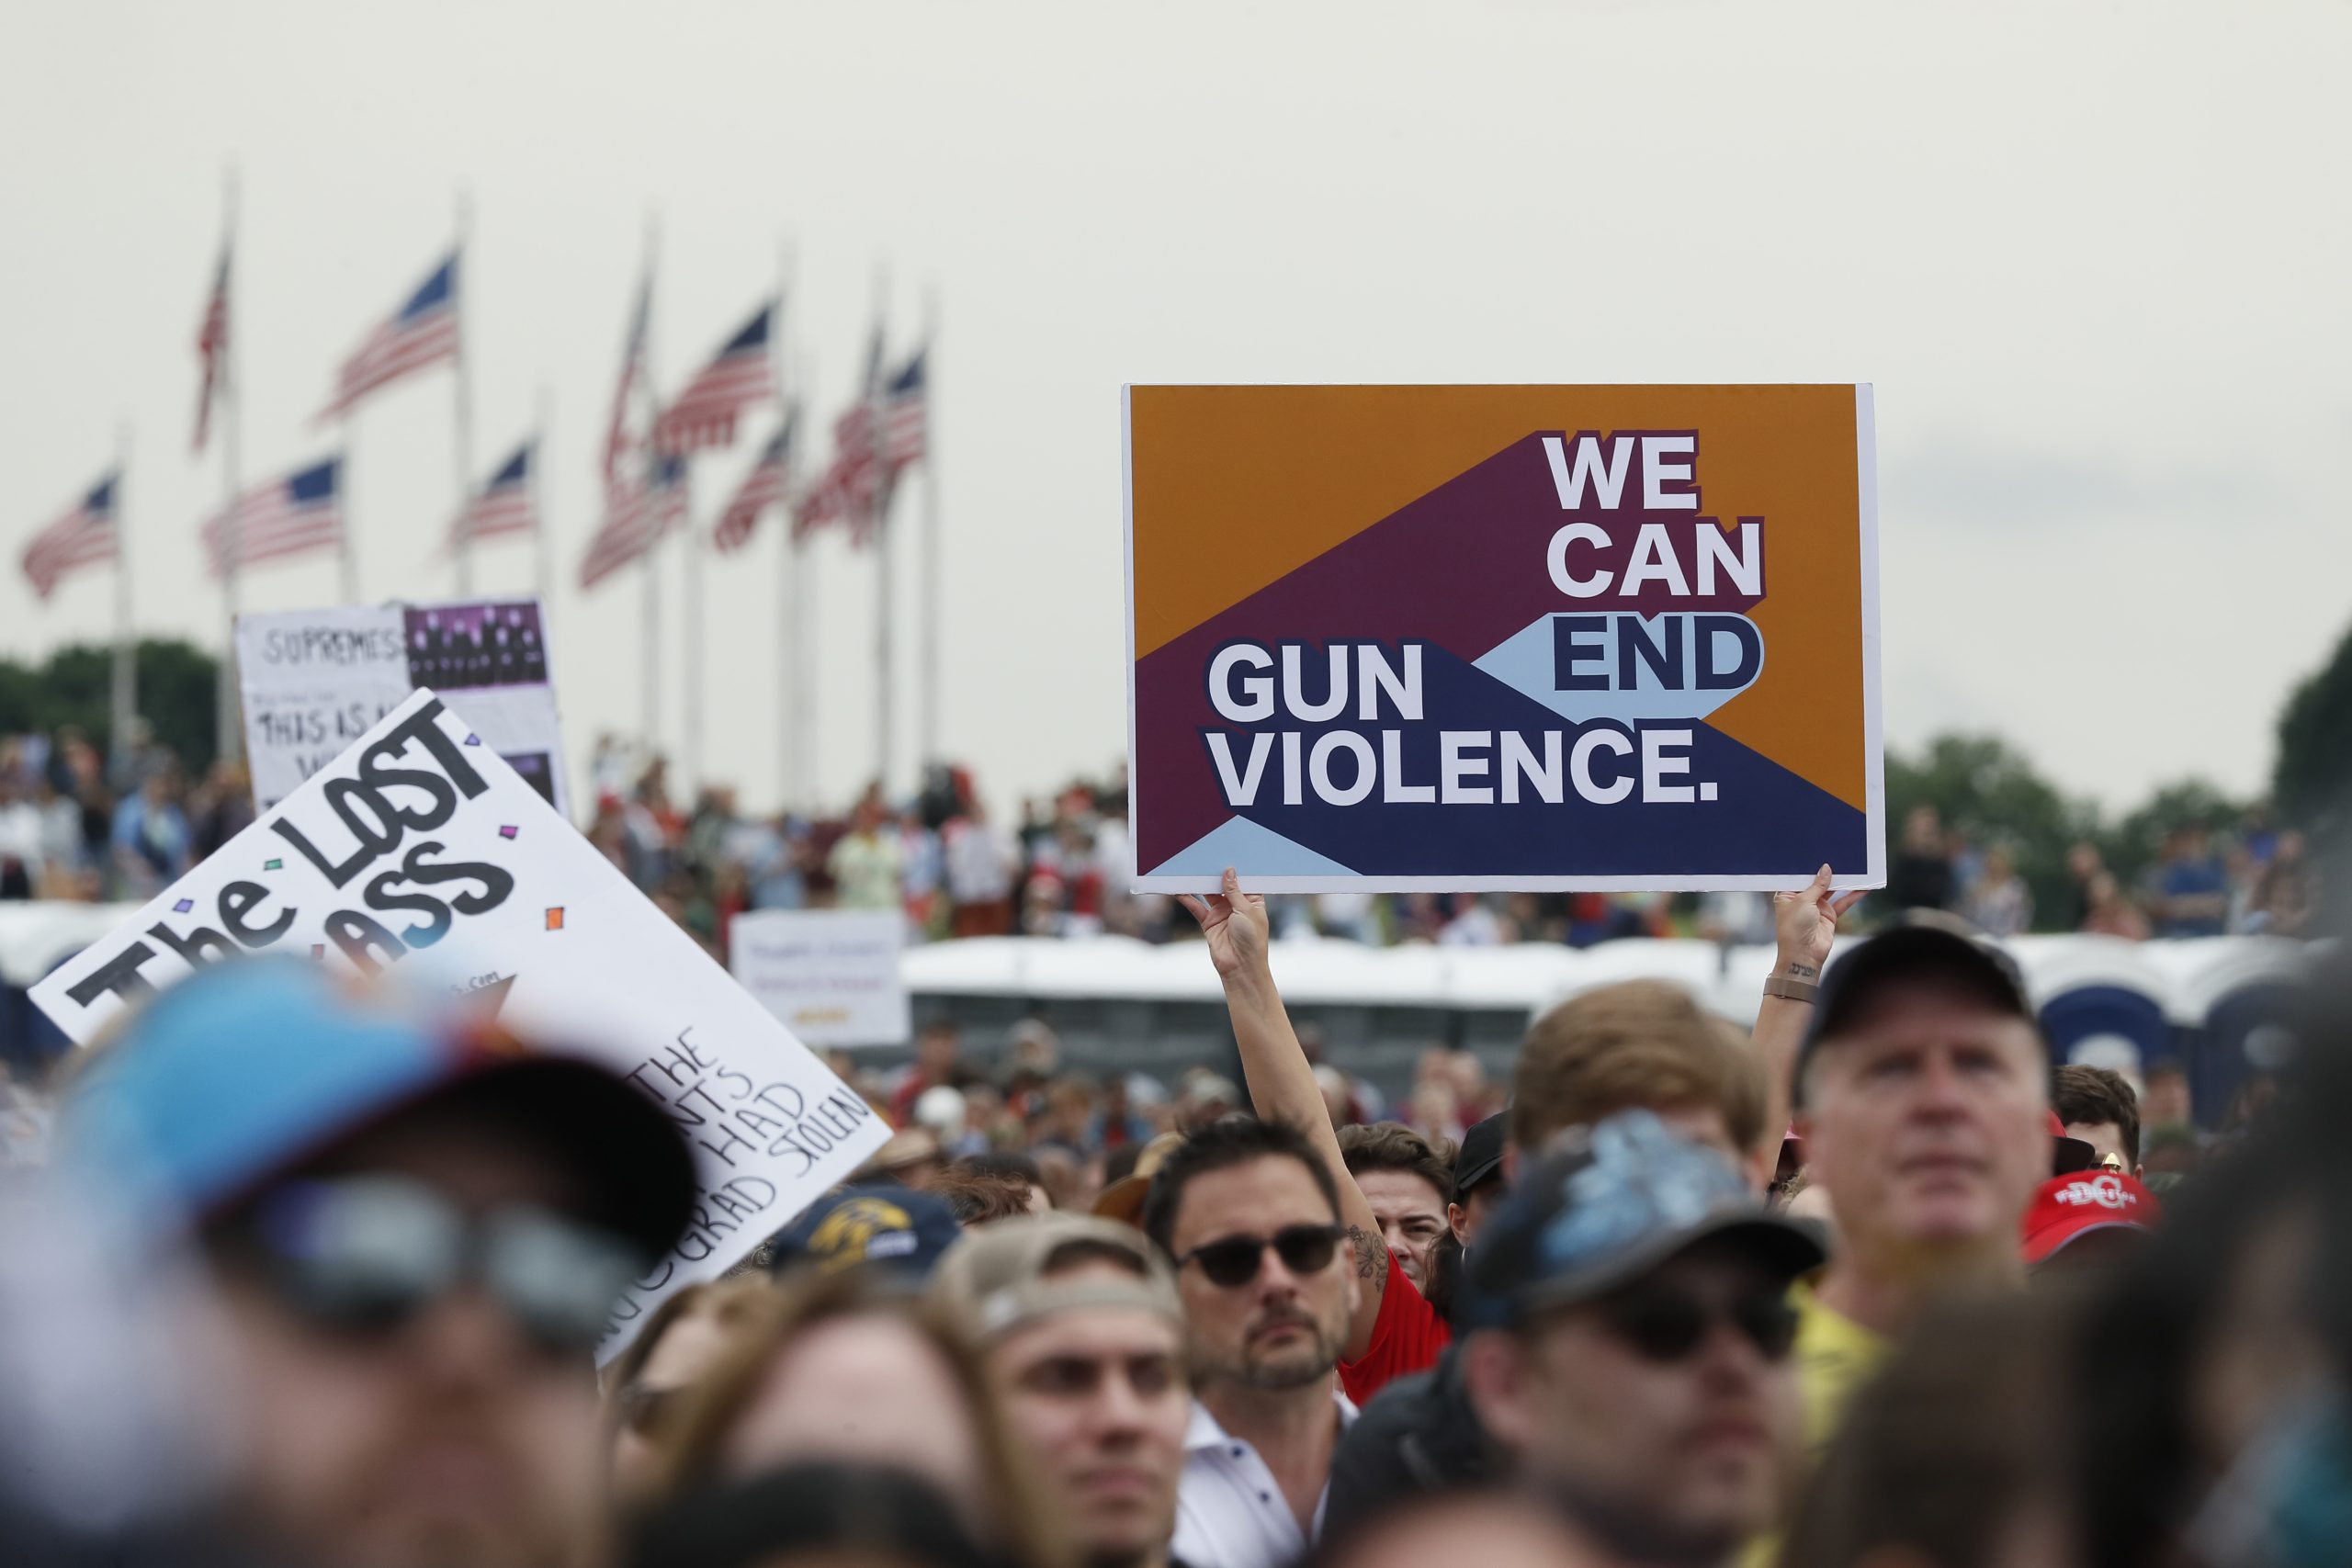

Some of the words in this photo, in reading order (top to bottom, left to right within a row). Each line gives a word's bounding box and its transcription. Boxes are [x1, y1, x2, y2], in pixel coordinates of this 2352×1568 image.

[1542, 436, 1698, 510] WE
[1546, 522, 1761, 598] CAN
[1208, 643, 1425, 722] GUN
[1552, 615, 1761, 691] END
[257, 709, 326, 745] THIS
[336, 701, 368, 739] IS
[270, 698, 491, 889] LOST
[1204, 728, 1719, 807] VIOLENCE.
[323, 840, 514, 979] ASS
[624, 1026, 718, 1102] THE
[698, 1083, 804, 1167] HAD
[675, 1176, 776, 1261] GRAD
[768, 1087, 869, 1179] STOLEN
